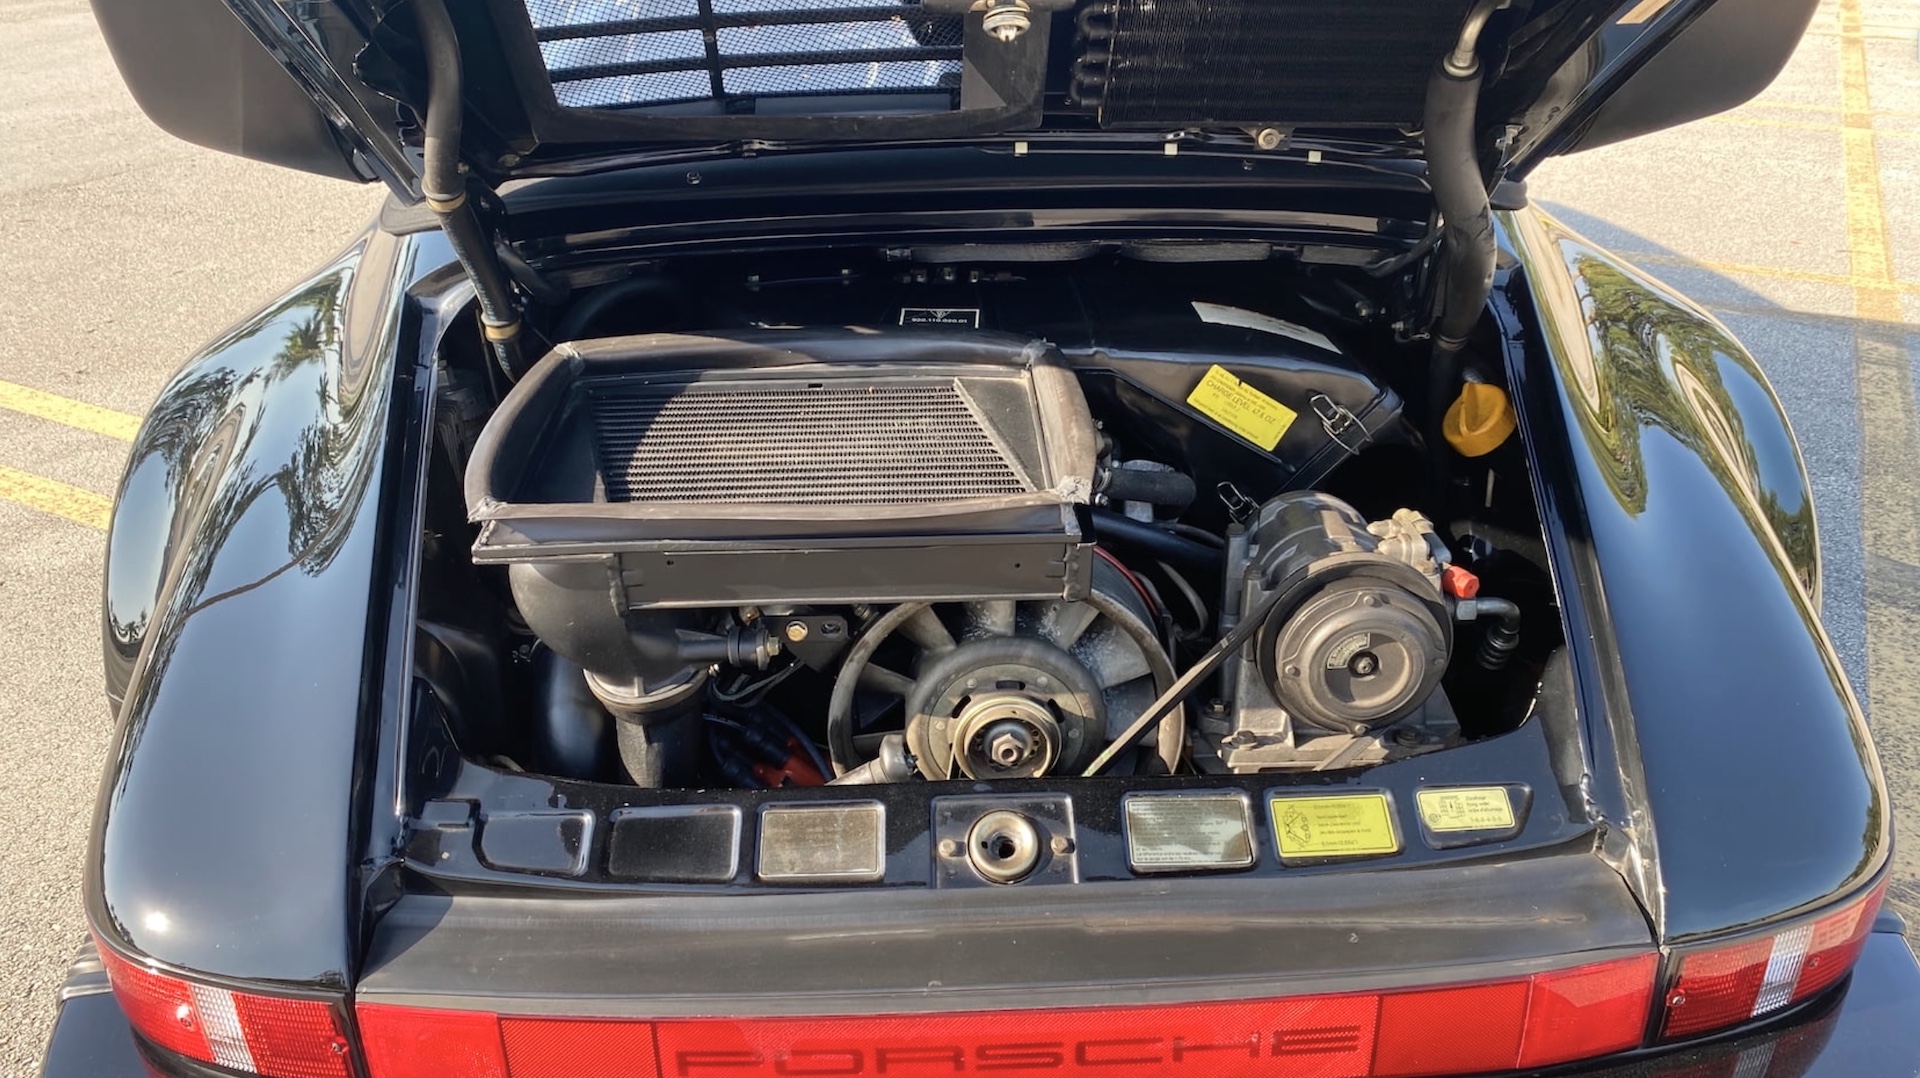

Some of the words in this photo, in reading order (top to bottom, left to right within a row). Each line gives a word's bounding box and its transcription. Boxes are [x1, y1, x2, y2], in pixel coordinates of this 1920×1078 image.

[1206, 380, 1233, 399] CHARGE
[1231, 396, 1251, 411] LEVEL
[676, 1025, 1361, 1078] PORSCHE
